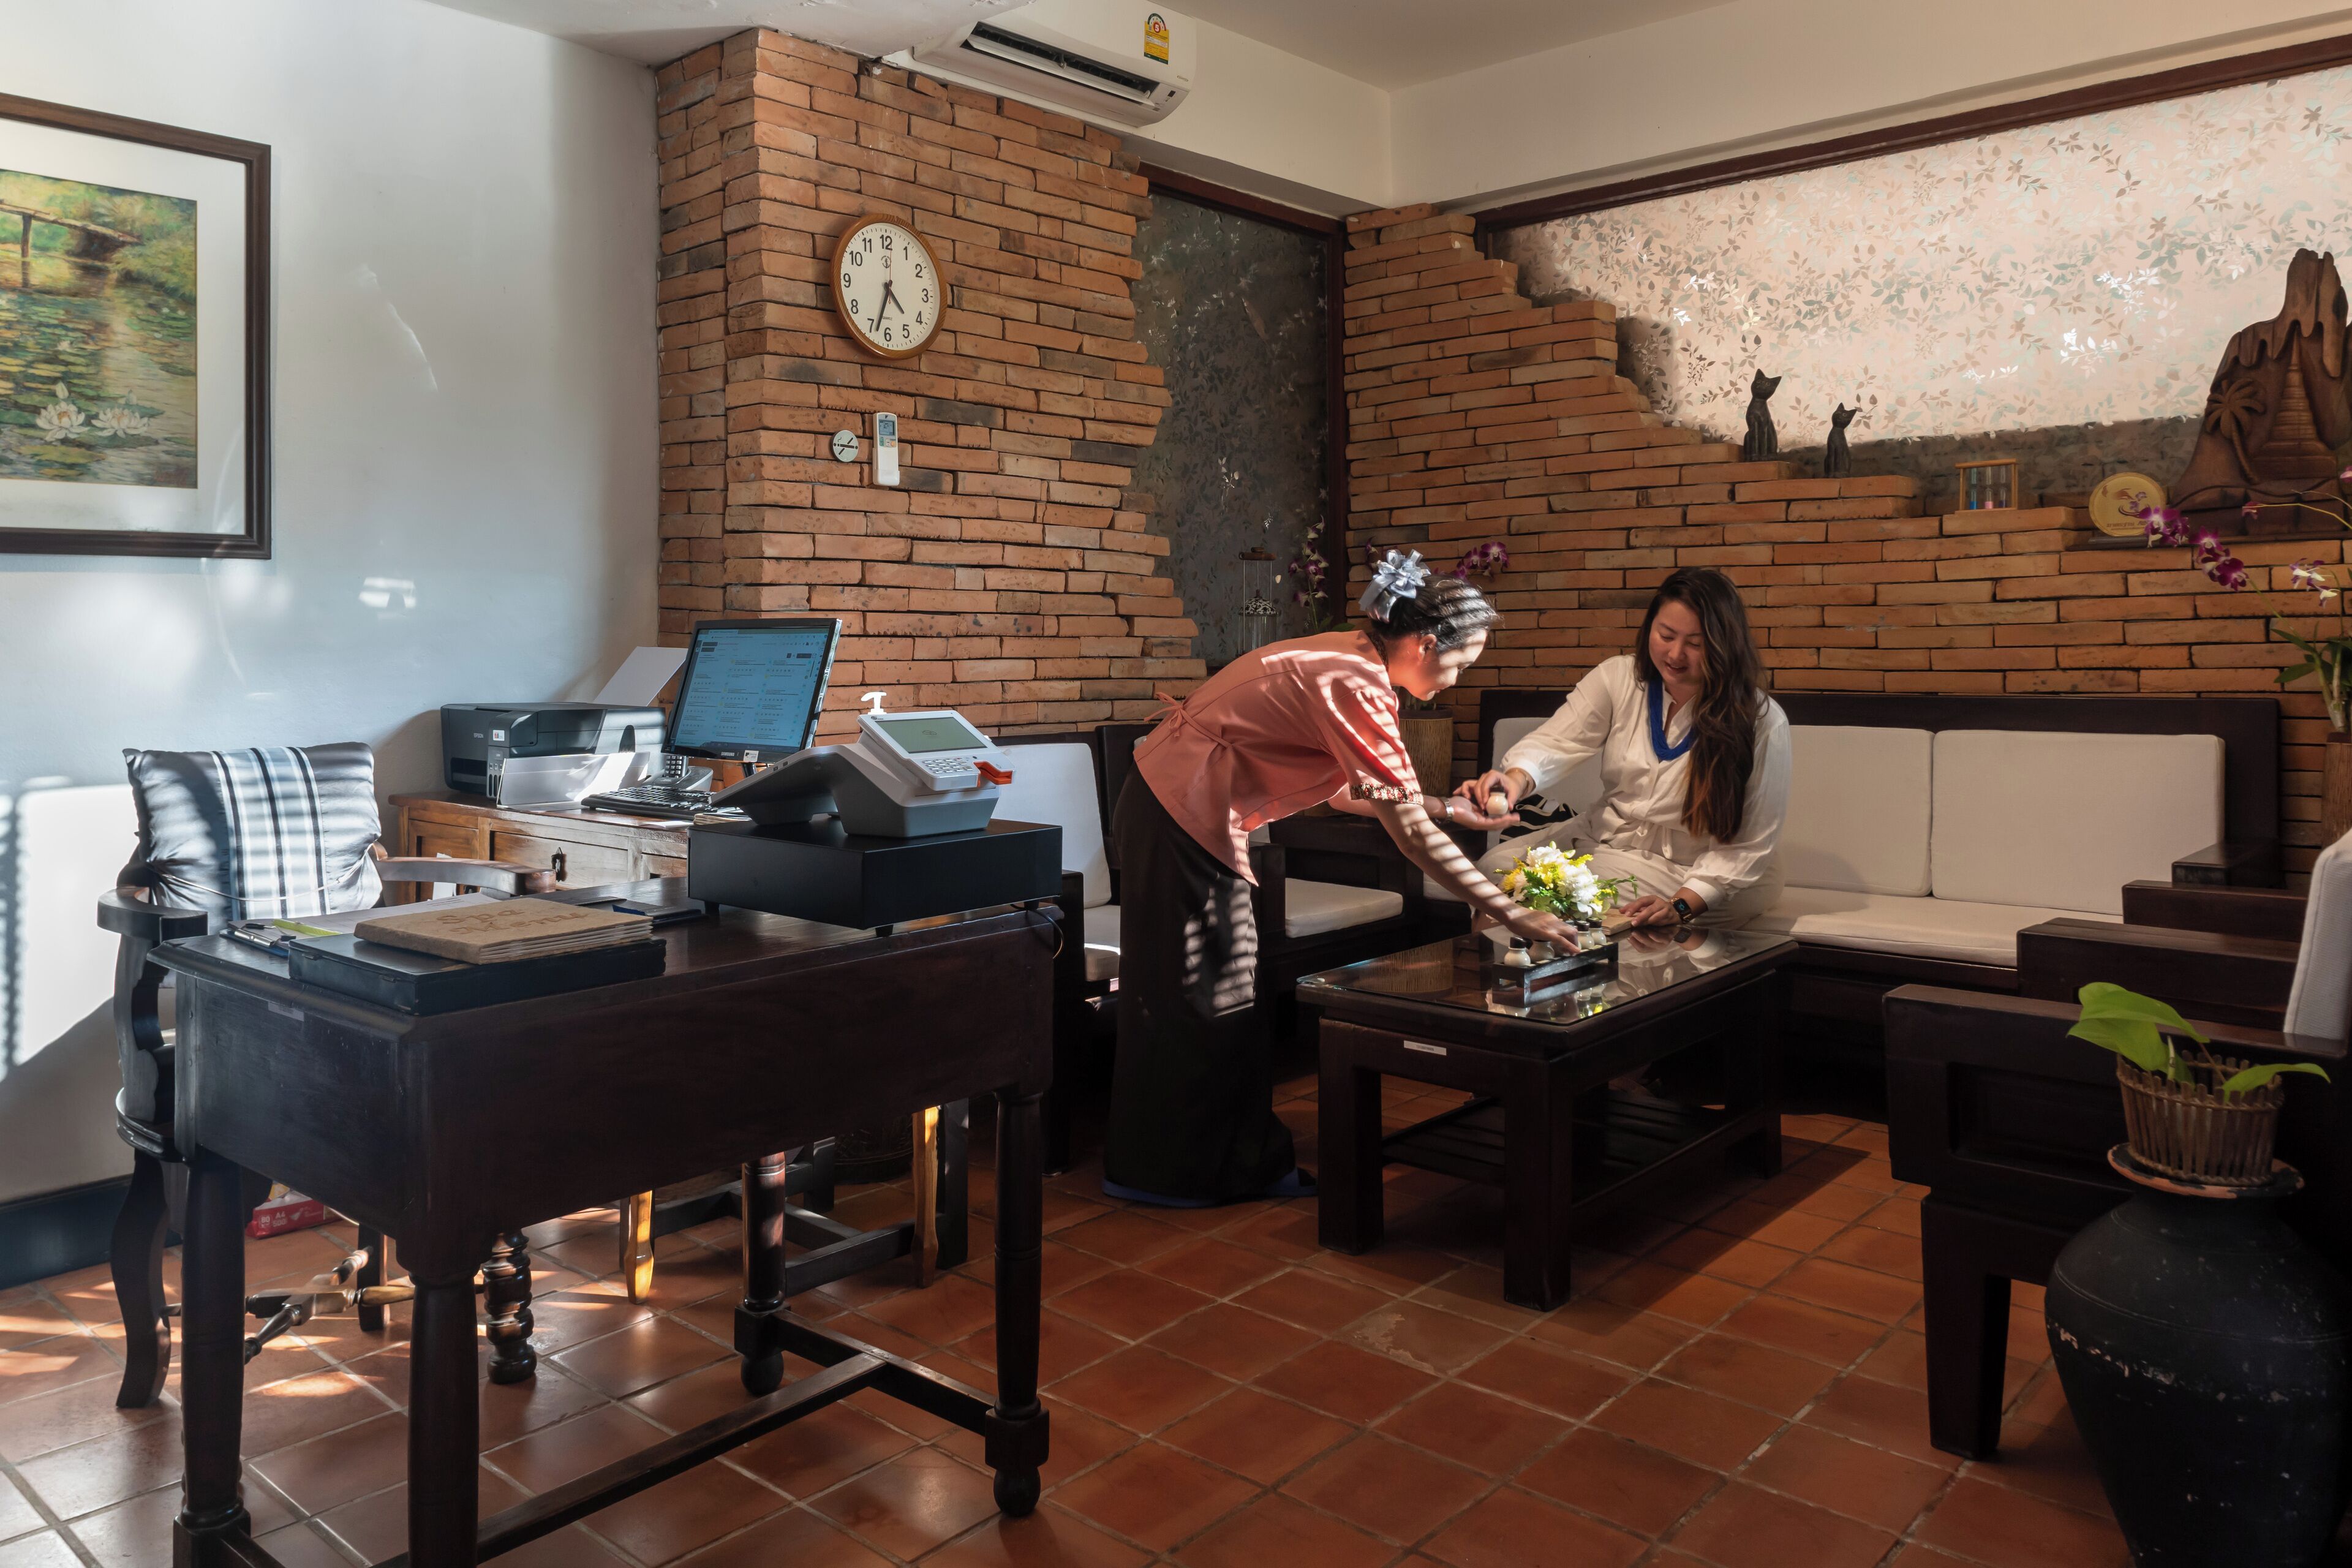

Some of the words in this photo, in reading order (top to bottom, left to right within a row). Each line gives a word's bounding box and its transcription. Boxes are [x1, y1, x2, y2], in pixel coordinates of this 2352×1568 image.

[862, 237, 872, 253] 11
[880, 235, 892, 251] 12
[849, 251, 862, 266] 10
[903, 246, 908, 260] 1
[914, 263, 922, 278] 2
[843, 273, 851, 288] 9
[921, 288, 929, 303] 3
[851, 299, 858, 314] 8
[867, 318, 875, 333] 7
[916, 311, 923, 325] 4
[884, 327, 891, 342] 6
[902, 324, 910, 339] 5
[436, 910, 524, 924] Spa
[449, 912, 590, 934] Menu
